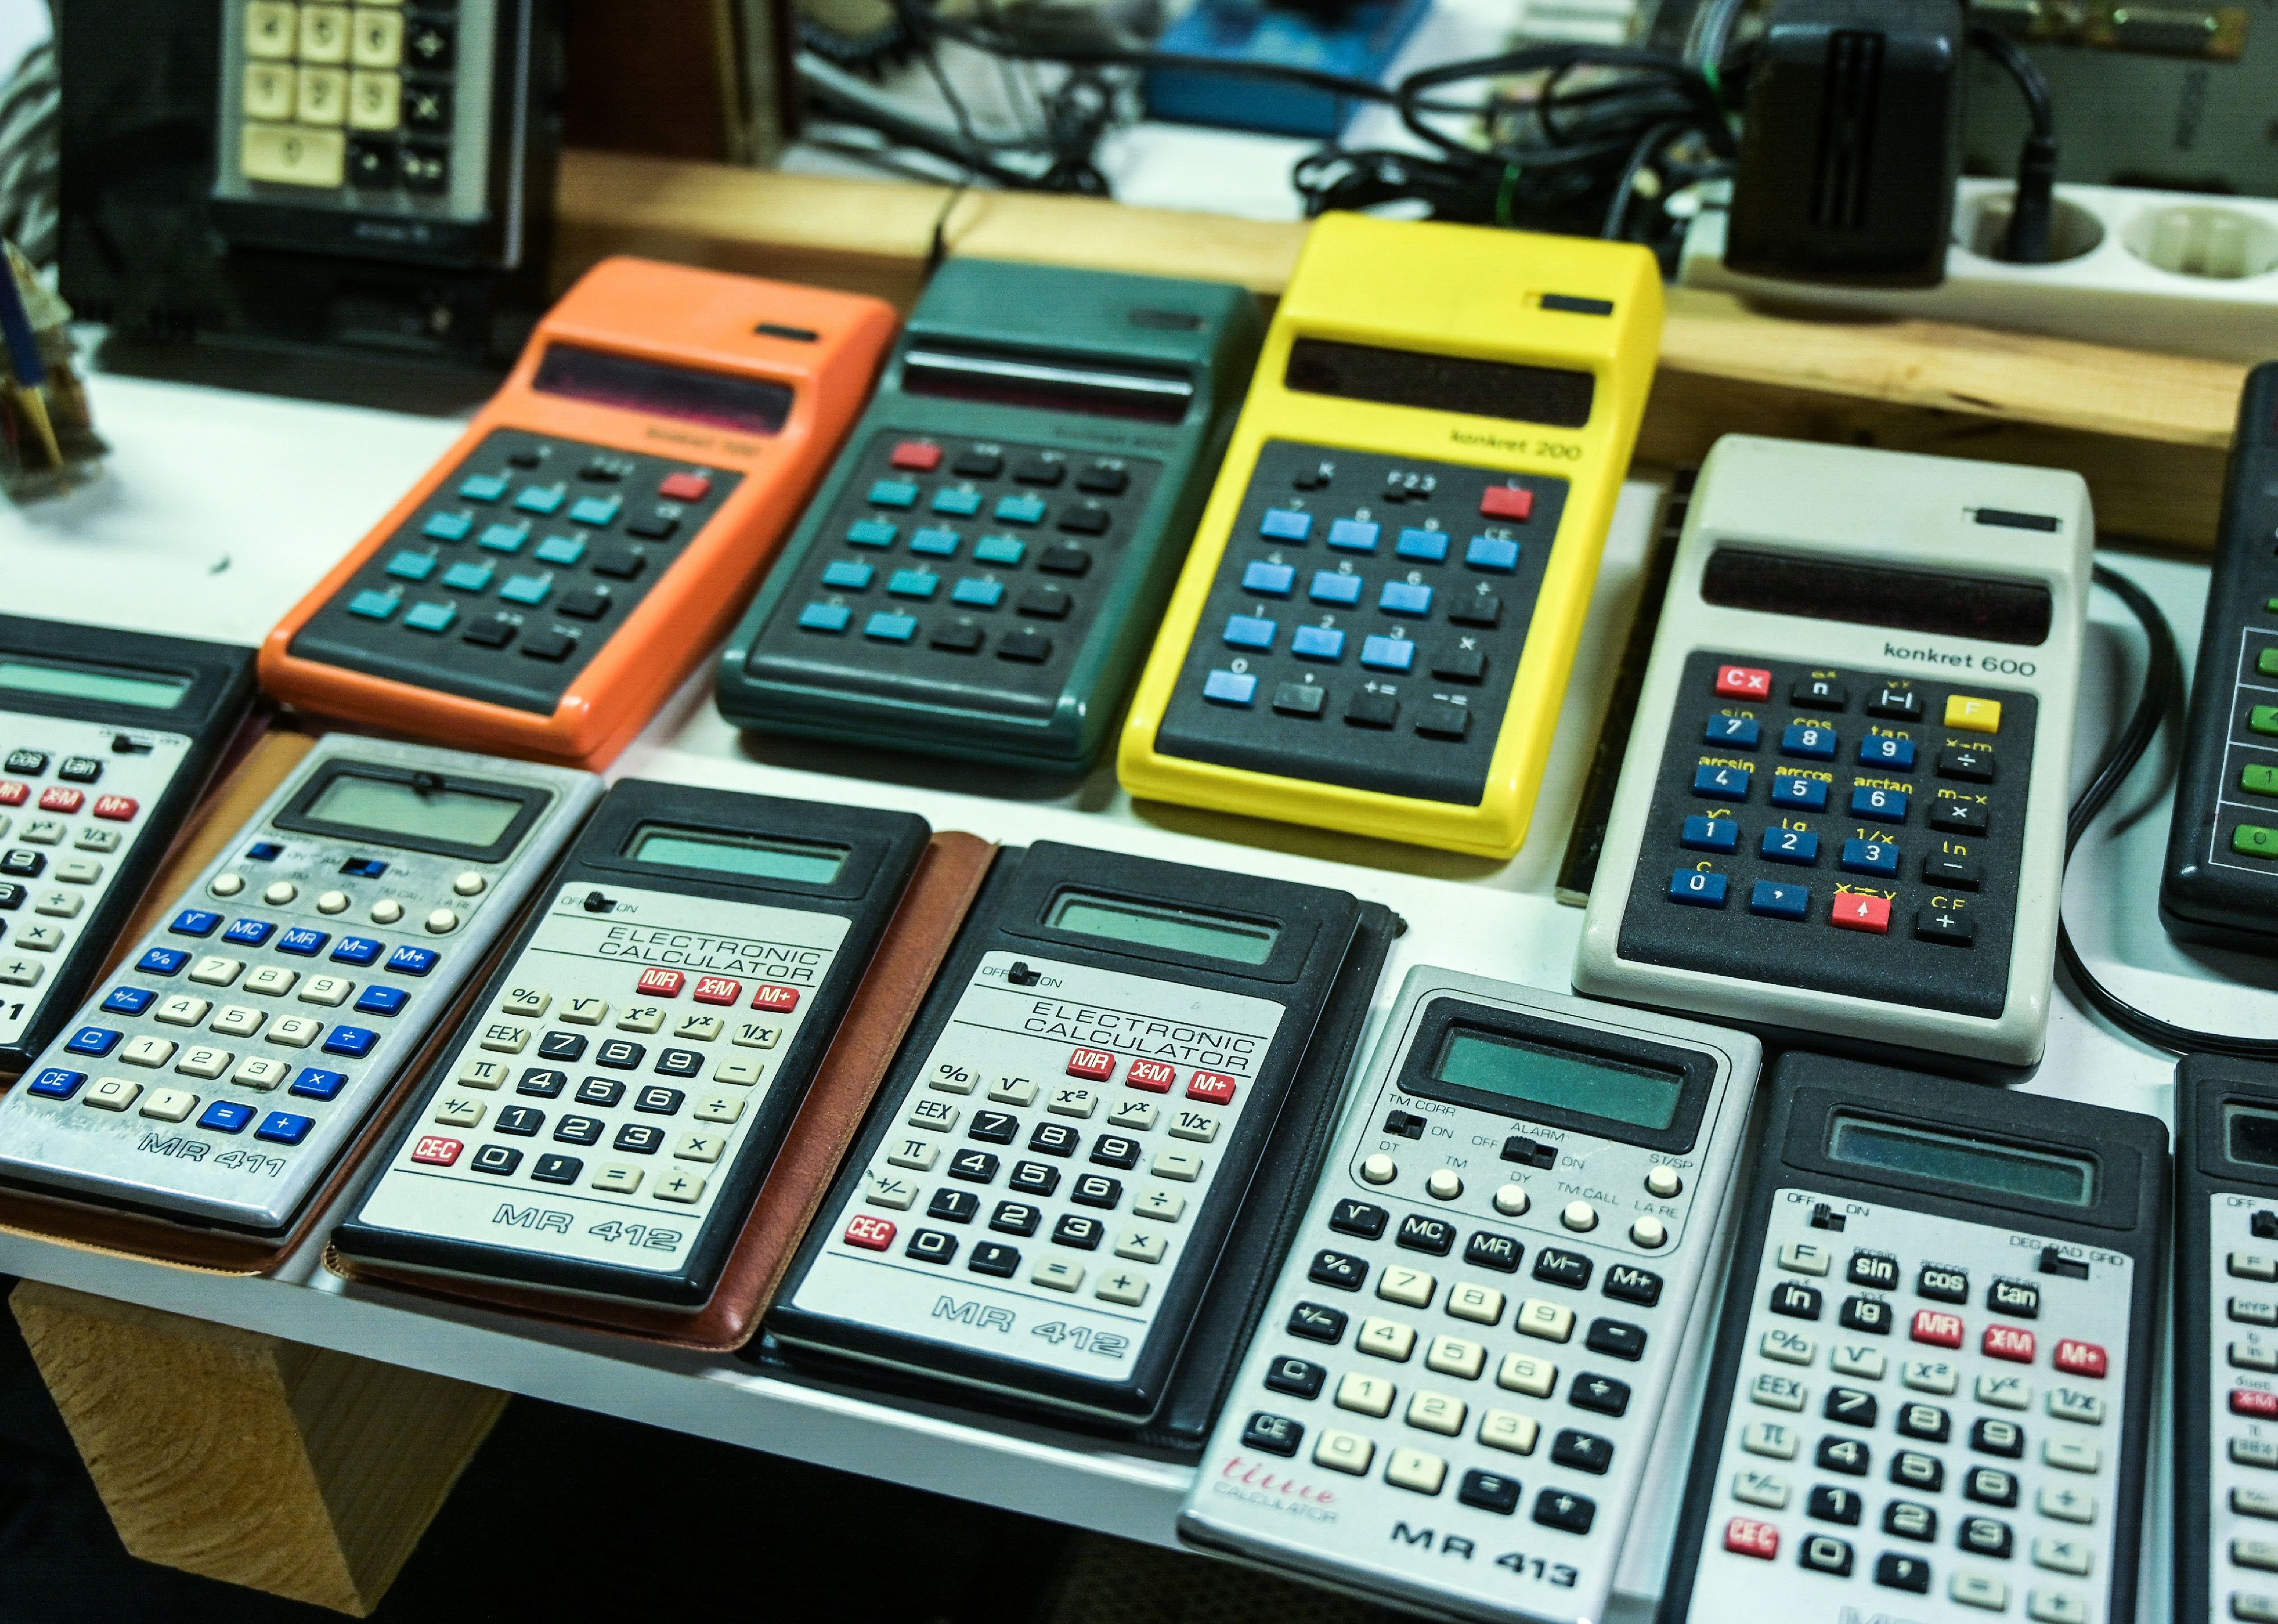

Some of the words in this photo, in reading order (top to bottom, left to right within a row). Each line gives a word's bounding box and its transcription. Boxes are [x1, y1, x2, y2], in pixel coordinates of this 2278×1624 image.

[1450, 430, 1526, 454] konkret
[1537, 442, 1582, 460] 200
[1232, 659, 1248, 673] 0
[1884, 643, 1973, 668] konkret
[1982, 657, 2036, 676] 600
[1965, 703, 1980, 715] F
[1727, 720, 1740, 734] 7
[1793, 717, 1831, 731] cos
[1803, 731, 1817, 745] 8
[1882, 741, 1896, 757] 9
[1698, 755, 1754, 773] arcsin
[1715, 769, 1728, 785] 4
[1775, 764, 1833, 784] arccos
[2266, 770, 2272, 782] 1
[1792, 781, 1807, 797] 5
[1854, 777, 1913, 795] arctan
[100, 798, 129, 811] M+
[1872, 791, 1885, 807] 6
[1706, 822, 1715, 837] 1
[1783, 834, 1796, 850] 2
[1943, 842, 1966, 856] ln
[10, 851, 36, 866] 9
[1866, 846, 1879, 861] 3
[1690, 875, 1705, 890] 0
[617, 904, 638, 913] ON
[230, 920, 263, 934] MC
[285, 931, 317, 944] MR
[608, 927, 821, 965] ELECTRONIC
[394, 948, 425, 962] M+
[599, 942, 814, 981] CALCULATOR
[207, 960, 226, 970] 7
[258, 969, 278, 981] 8
[643, 970, 677, 987] MR
[983, 966, 1008, 977] OFF
[1040, 977, 1062, 988] ON
[313, 979, 333, 990] 9
[759, 986, 790, 1001] M+
[172, 1000, 190, 1011] 4
[226, 1010, 244, 1022] 5
[282, 1020, 301, 1031] 6
[742, 1024, 773, 1042] 1/x
[1033, 1001, 1256, 1054] ELECTRONIC
[81, 1030, 103, 1043] C
[486, 1026, 520, 1042] EEX
[553, 1035, 576, 1049] 7
[142, 1040, 154, 1052] 1
[607, 1044, 632, 1059] 8
[1025, 1018, 1249, 1071] CALCULATOR
[191, 1050, 212, 1063] 2
[667, 1053, 691, 1068] 9
[1073, 1050, 1107, 1070] MR
[248, 1061, 268, 1073] 3
[41, 1071, 68, 1086] CE
[529, 1072, 551, 1087] 4
[1195, 1075, 1226, 1091] M+
[100, 1081, 120, 1093] 0
[586, 1080, 613, 1097] 5
[646, 1089, 671, 1106] 6
[1388, 1093, 1411, 1106] TM
[1416, 1099, 1455, 1117] CORR
[511, 1109, 524, 1125] 1
[915, 1101, 951, 1120] EEX
[562, 1119, 589, 1135] 2
[984, 1114, 1006, 1129] 7
[1180, 1112, 1210, 1131] 1/x
[624, 1128, 650, 1144] 3
[1040, 1127, 1067, 1142] 8
[1431, 1127, 1453, 1139] ON
[1511, 1123, 1564, 1142] ALARM
[1102, 1139, 1128, 1155] 9
[1472, 1136, 1499, 1148] OFF
[138, 1132, 210, 1162] MR
[215, 1150, 286, 1177] 411
[483, 1149, 509, 1165] 0
[961, 1154, 984, 1171] 4
[1445, 1156, 1468, 1168] TM
[1562, 1156, 1584, 1169] ON
[1021, 1165, 1048, 1181] 5
[1510, 1171, 1531, 1182] DY
[1083, 1178, 1109, 1194] 6
[1556, 1181, 1580, 1195] TM
[1583, 1188, 1618, 1205] CALL
[946, 1193, 959, 1210] 1
[1634, 1201, 1653, 1212] LA
[1660, 1206, 1678, 1218] RE
[1788, 1193, 1814, 1205] OFF
[1846, 1203, 1869, 1217] ON
[2227, 1197, 2255, 1207] OFF
[1000, 1206, 1028, 1225] 2
[493, 1203, 574, 1233] MR
[589, 1221, 682, 1251] 412
[1063, 1219, 1090, 1237] 3
[1405, 1218, 1442, 1239] MC
[918, 1232, 944, 1250] 0
[1473, 1235, 1511, 1256] MR
[2010, 1236, 2040, 1250] DEG
[1795, 1244, 1816, 1259] F
[1613, 1267, 1651, 1284] M+
[1856, 1258, 1892, 1278] sin
[1396, 1272, 1417, 1287] 7
[1924, 1270, 1963, 1291] cos
[1464, 1290, 1484, 1304] 8
[1785, 1292, 1810, 1307] ln
[1997, 1282, 2036, 1307] tan
[1535, 1306, 1556, 1321] 9
[1855, 1301, 1878, 1322] lg
[932, 1296, 1016, 1332] MR
[1032, 1321, 1129, 1358] 412
[1918, 1312, 1958, 1335] MR
[1375, 1325, 1395, 1341] 4
[1444, 1344, 1464, 1359] 5
[2062, 1343, 2098, 1363] M+
[1283, 1361, 1308, 1380] C
[1514, 1361, 1535, 1377] 6
[1360, 1381, 1371, 1396] 1
[1758, 1375, 1801, 1396] EEX
[1424, 1398, 1446, 1416] 2
[1837, 1390, 1867, 1410] 7
[1909, 1405, 1940, 1427] 8
[1256, 1415, 1289, 1438] CE
[1496, 1416, 1518, 1433] 3
[1983, 1421, 2015, 1444] 9
[1332, 1436, 1354, 1454] 0
[1828, 1442, 1857, 1462] 4
[1222, 1455, 1337, 1505] time
[1212, 1481, 1340, 1524] CALCULATOR
[1826, 1490, 1845, 1513] 1
[1893, 1504, 1928, 1529] 2
[1391, 1521, 1476, 1561] MR
[1494, 1550, 1580, 1588] 413
[1811, 1538, 1845, 1564] 0
